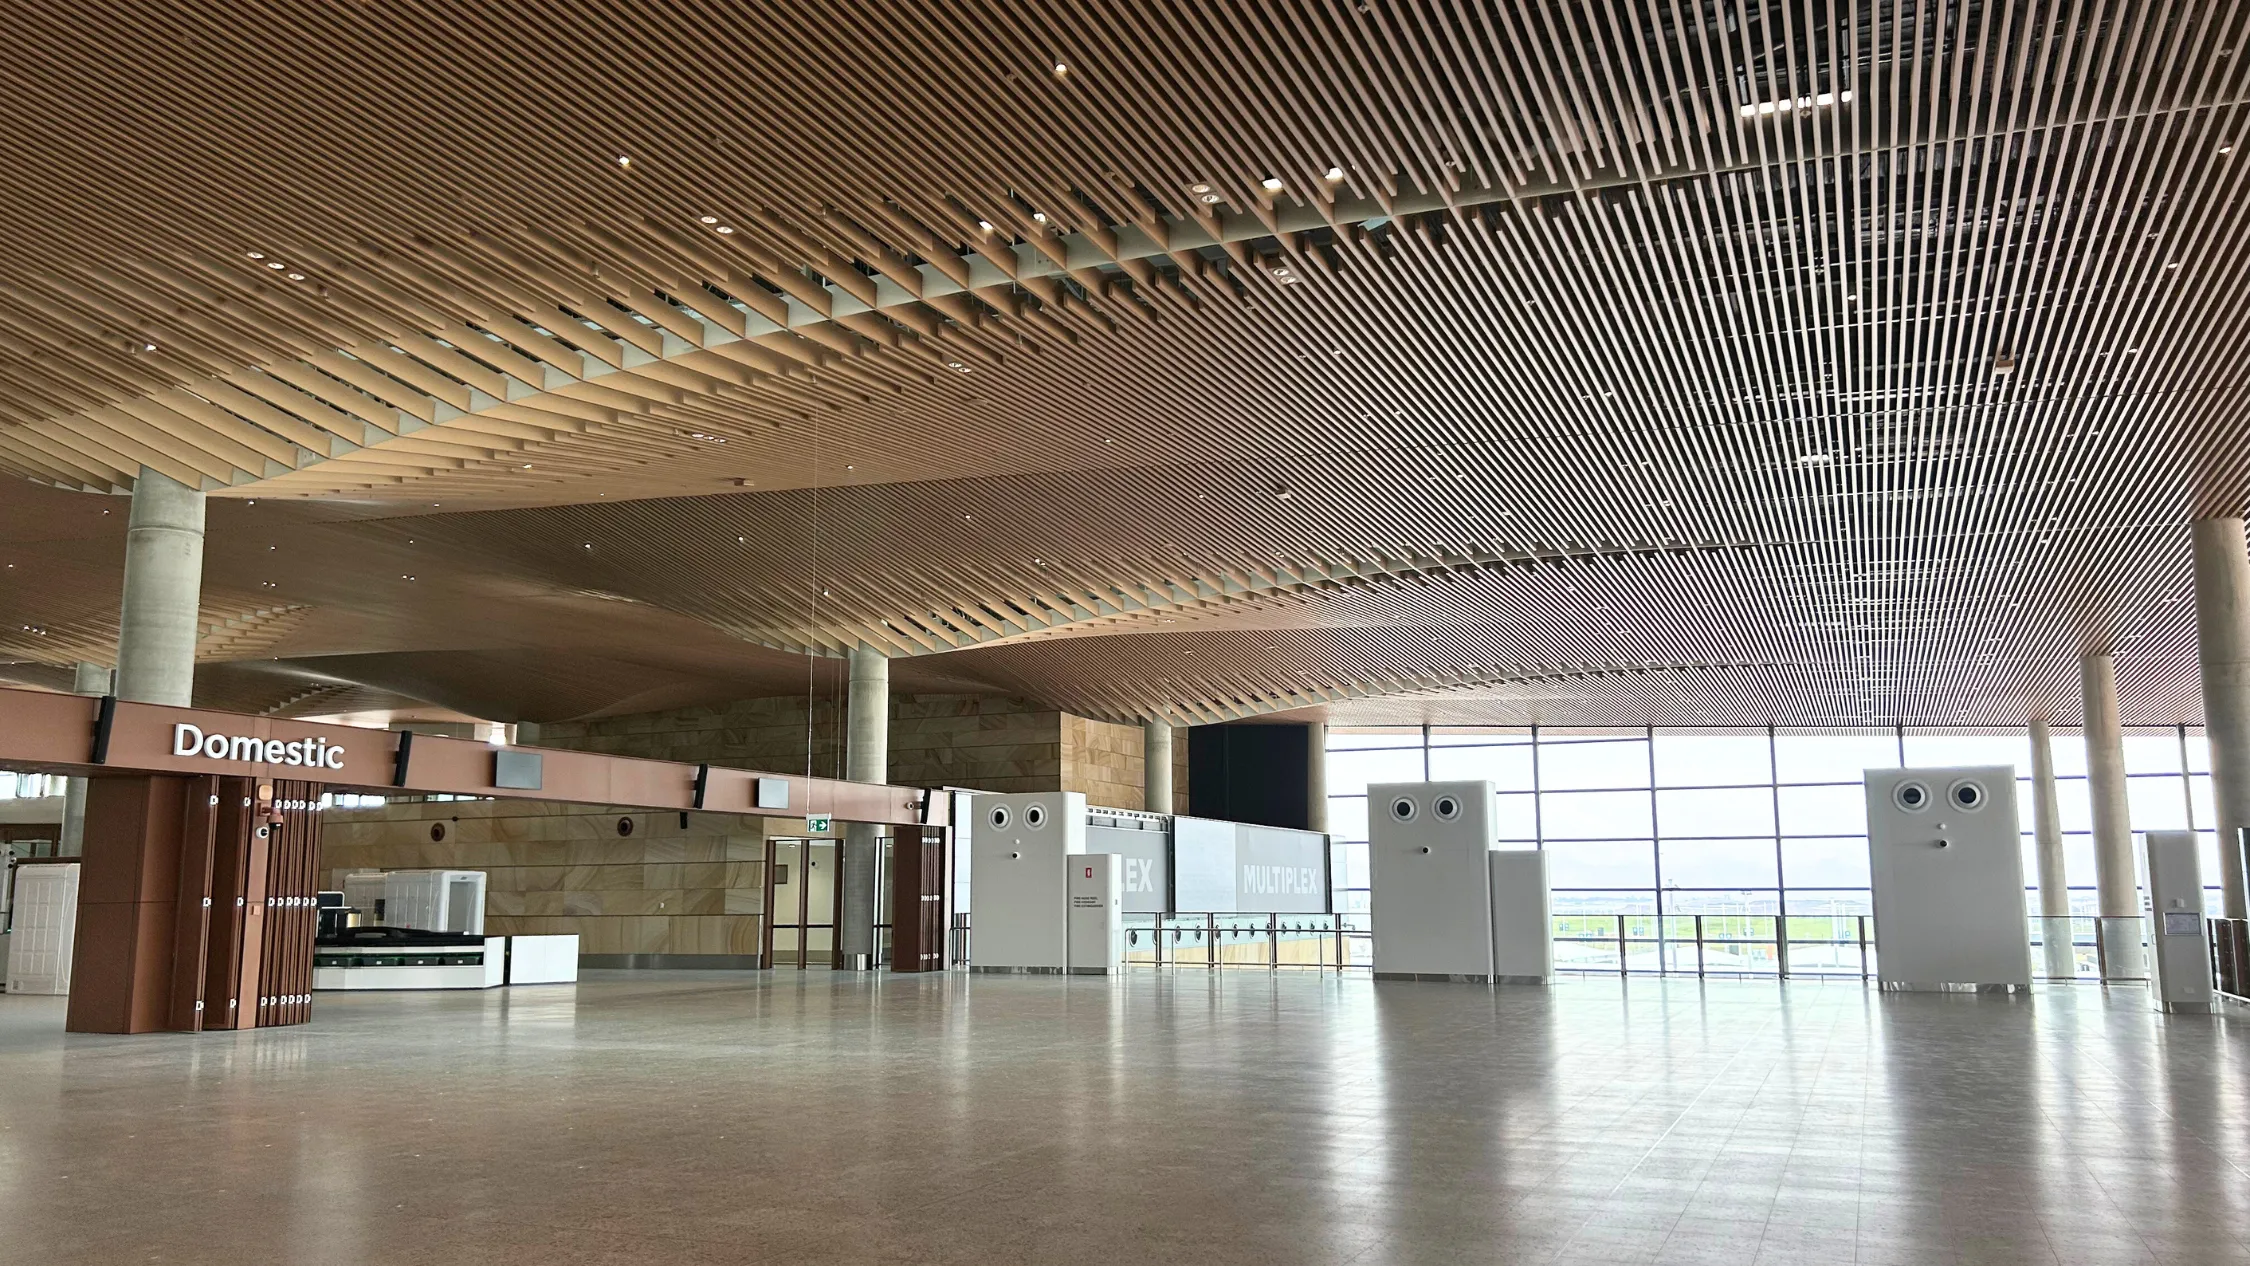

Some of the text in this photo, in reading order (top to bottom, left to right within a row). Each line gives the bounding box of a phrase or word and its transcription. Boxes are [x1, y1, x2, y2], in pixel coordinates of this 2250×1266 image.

[173, 722, 345, 769] Domestic
[1121, 858, 1153, 892] EX
[1243, 864, 1318, 894] MULTIPLEX
